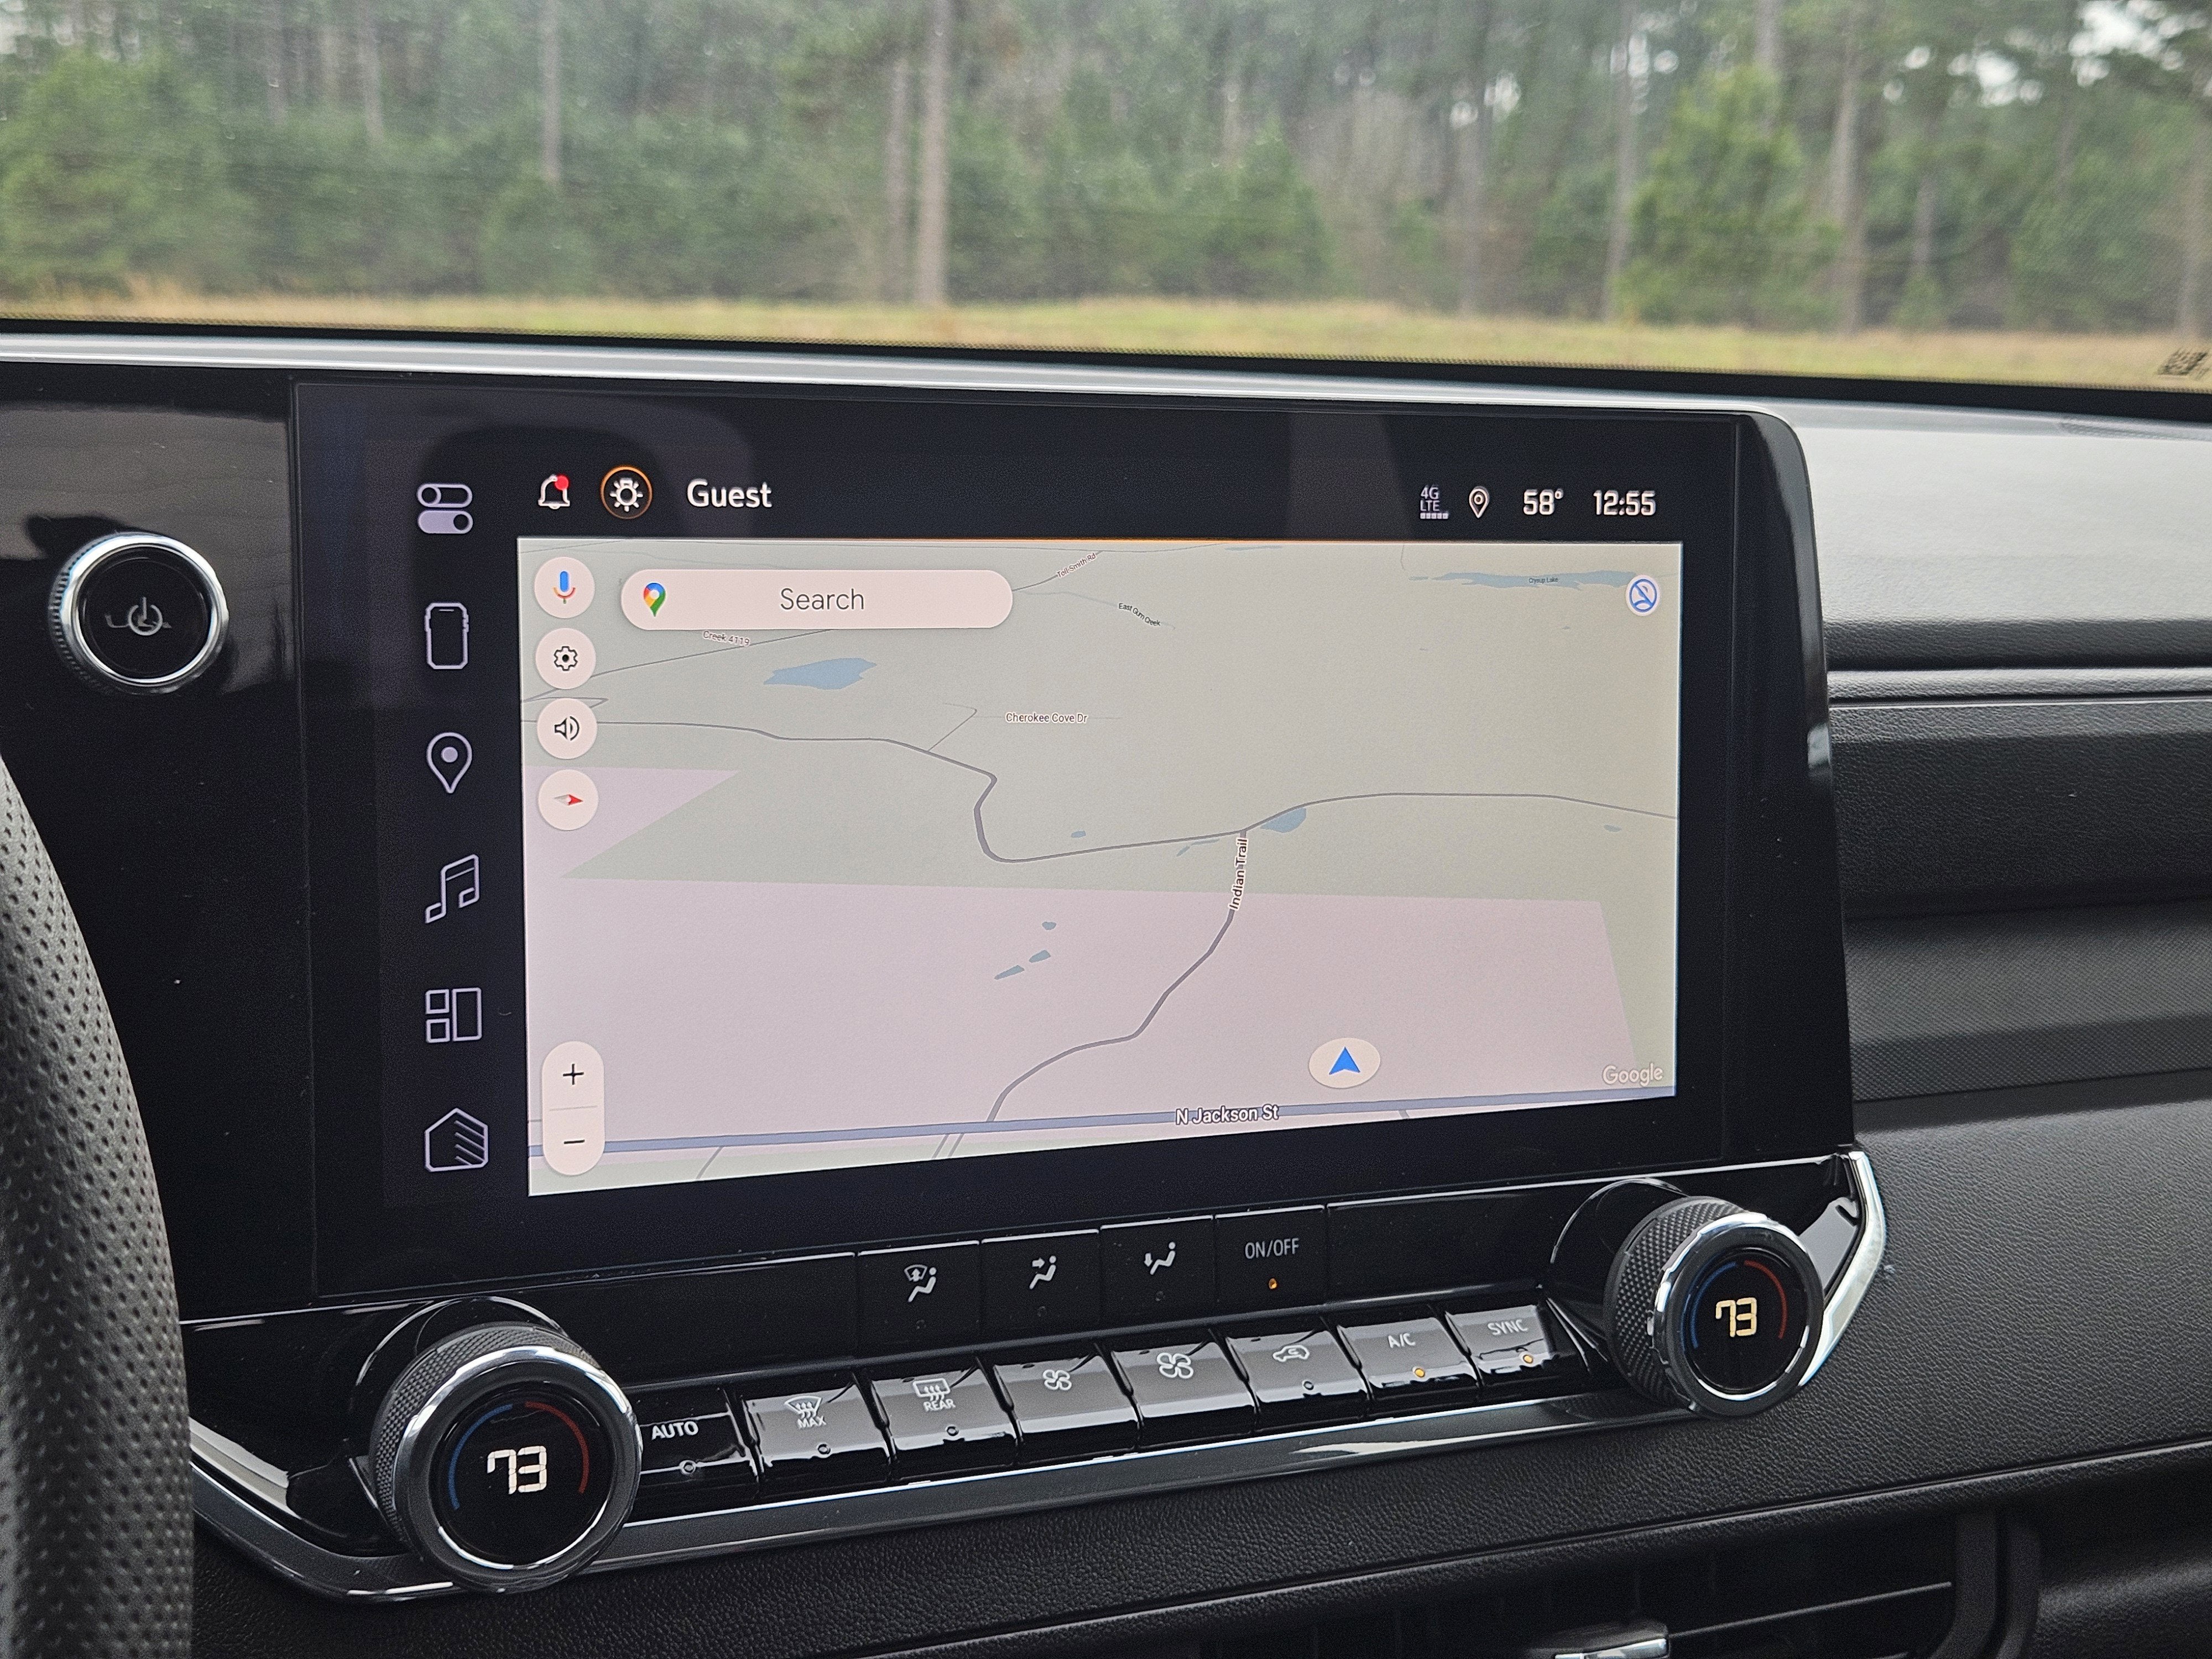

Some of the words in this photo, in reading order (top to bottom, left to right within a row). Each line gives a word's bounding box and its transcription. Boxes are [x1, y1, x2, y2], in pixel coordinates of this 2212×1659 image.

[686, 478, 773, 509] Guest
[1420, 485, 1439, 499] 4G
[1523, 488, 1564, 515] 58°
[1593, 489, 1656, 516] 12:55
[1420, 500, 1441, 512] LTE
[780, 587, 865, 611] Search
[1119, 602, 1133, 611] East
[1145, 616, 1161, 627] Creek
[703, 630, 726, 641] Creek
[728, 635, 750, 646] 4119
[1006, 712, 1050, 722] Cherokee
[1052, 713, 1074, 722] Cove
[1078, 713, 1087, 723] Dr
[1235, 838, 1248, 866] Trail
[1229, 870, 1245, 909] Indian
[1603, 1062, 1663, 1087] Google
[1175, 1108, 1189, 1125] N
[1192, 1105, 1258, 1124] Jackson
[1262, 1104, 1279, 1120] St
[1244, 1237, 1300, 1259] ON/OFF
[1487, 1318, 1528, 1335] SYNC
[1715, 1297, 1757, 1338] 73
[1387, 1333, 1416, 1348] A/C
[923, 1400, 956, 1412] REAR
[651, 1421, 699, 1440] AUTO
[796, 1416, 827, 1429] MAX
[487, 1446, 547, 1494] 73
